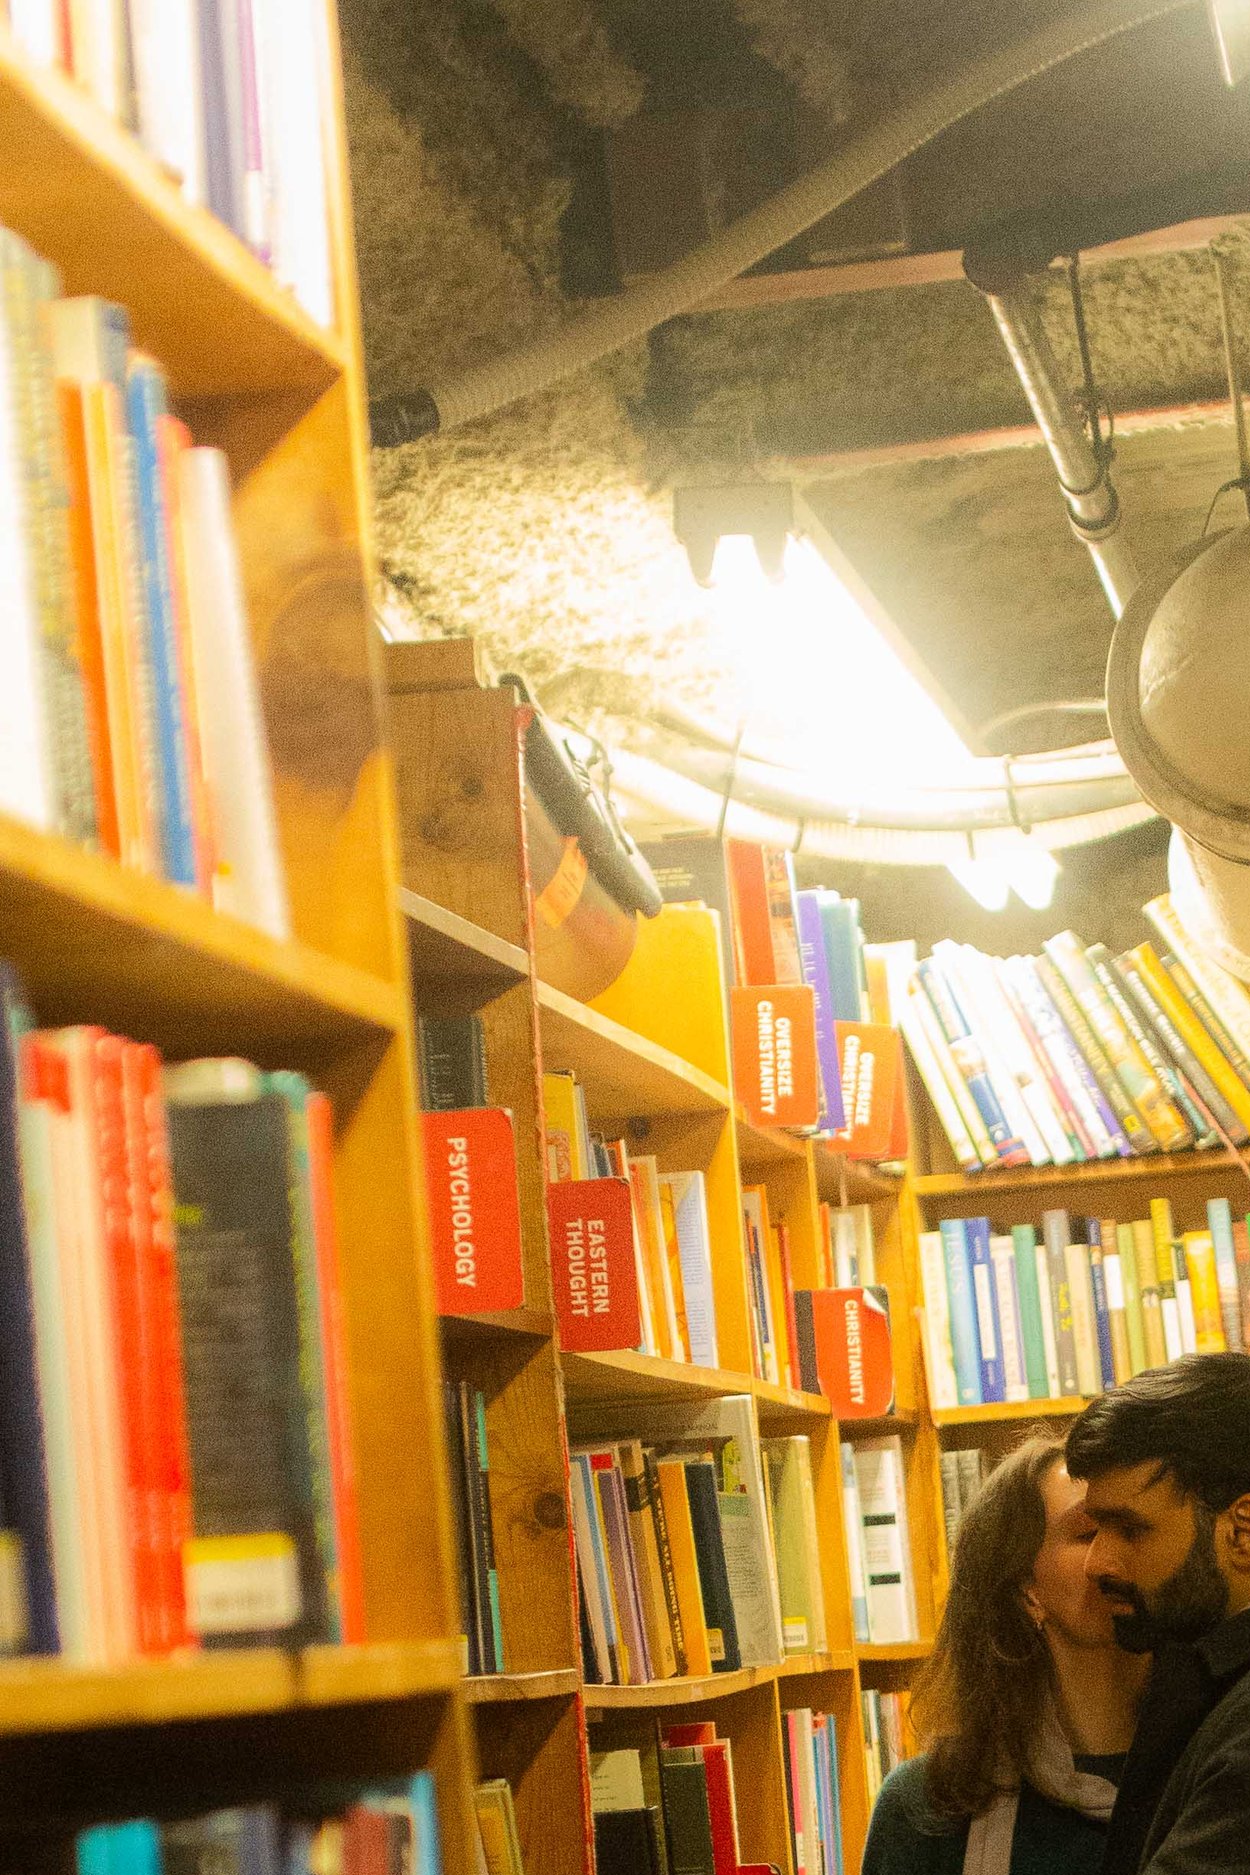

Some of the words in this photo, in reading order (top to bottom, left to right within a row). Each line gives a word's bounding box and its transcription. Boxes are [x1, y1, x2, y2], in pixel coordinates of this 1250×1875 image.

[755, 999, 776, 1115] CHRISTIANITY
[776, 1017, 793, 1097] OVERSIZE
[855, 1052, 874, 1125] OVERSIZE
[449, 1136, 477, 1288] PSYCHOLOGY
[564, 1218, 590, 1318] THOUGHT
[586, 1219, 610, 1314] EASTERN
[843, 1300, 865, 1405] CHRISTIANITY
[662, 1544, 670, 1570] ALL
[666, 1572, 676, 1614] DOING
[672, 1619, 683, 1651] TIME
